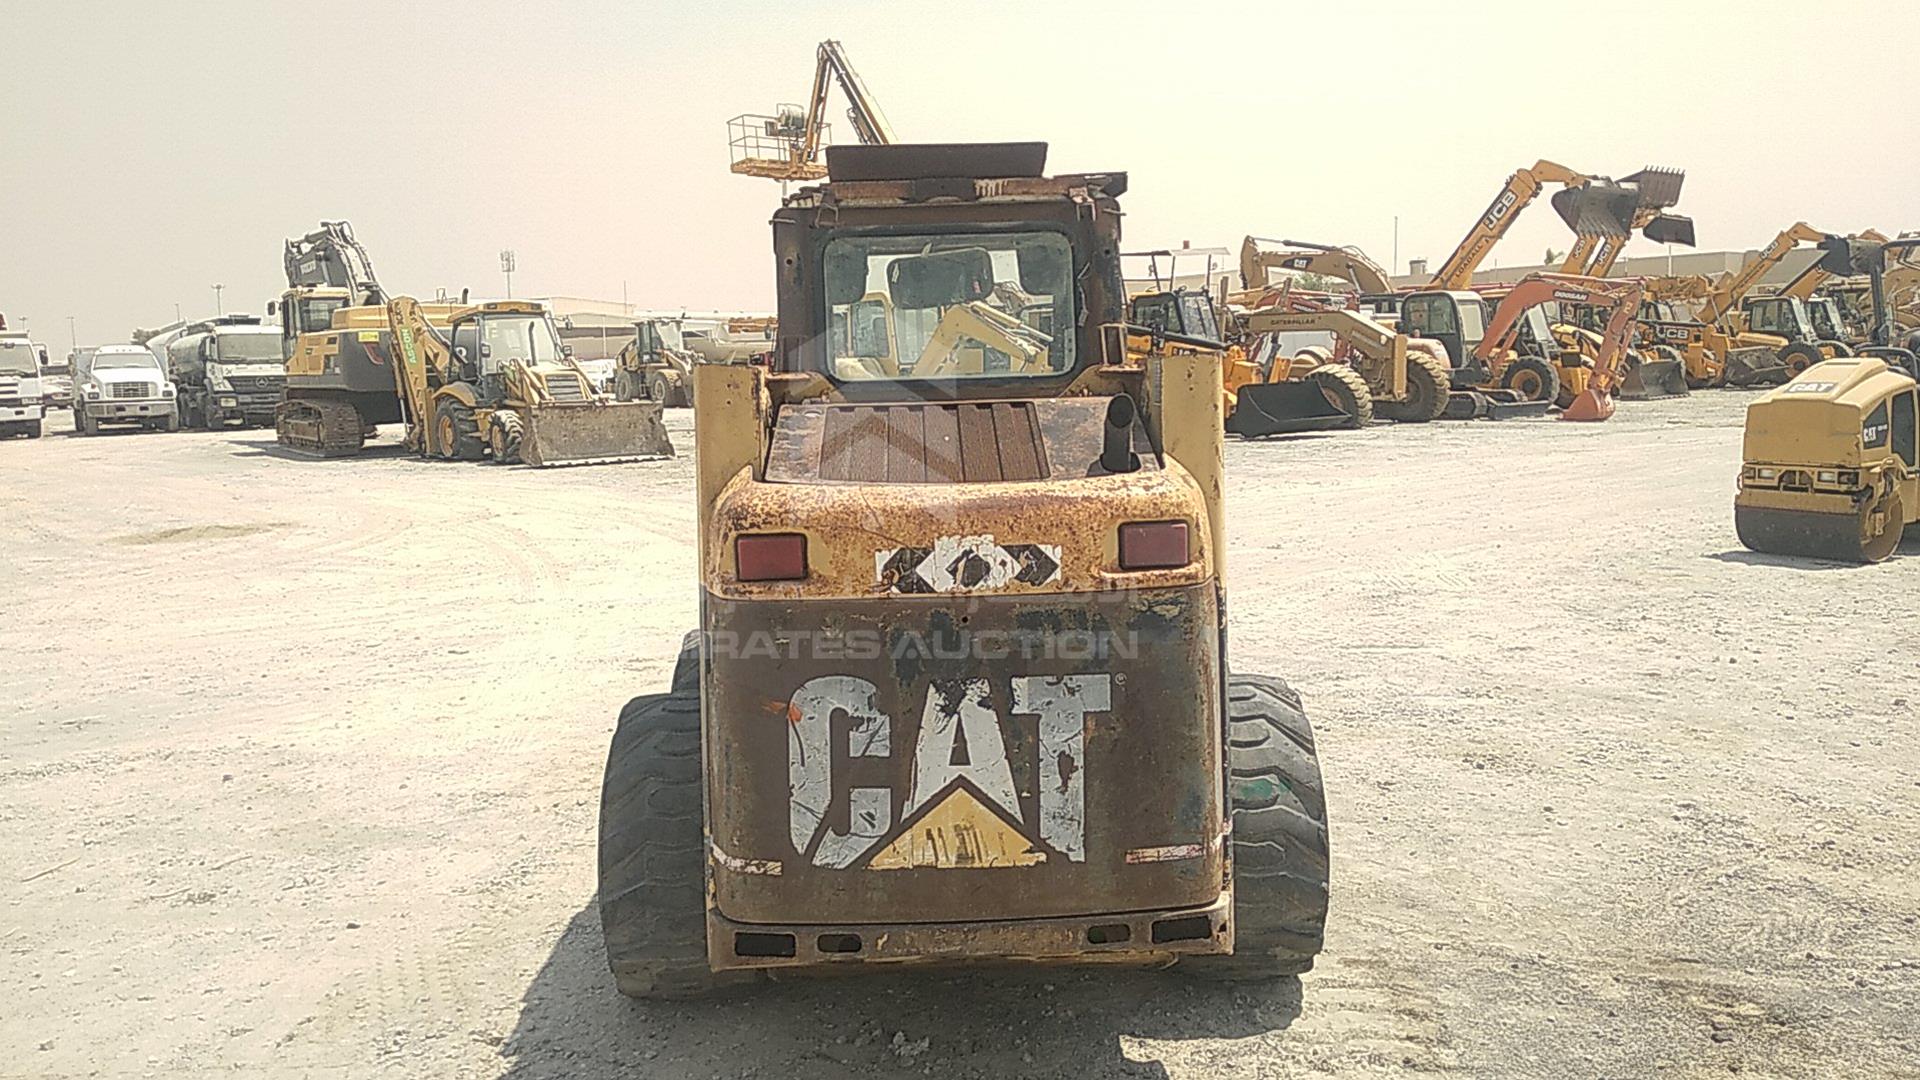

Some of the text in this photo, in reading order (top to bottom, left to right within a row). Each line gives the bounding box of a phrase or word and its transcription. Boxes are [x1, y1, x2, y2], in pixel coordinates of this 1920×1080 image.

[1484, 190, 1517, 229] JCB
[1760, 240, 1779, 260] JCB
[1294, 258, 1308, 268] CAT
[1553, 290, 1588, 301] DOOSAN
[1656, 325, 1689, 339] JCB
[1788, 382, 1835, 393] CAT
[1863, 426, 1877, 442] CAT
[786, 673, 1112, 870] CAT
